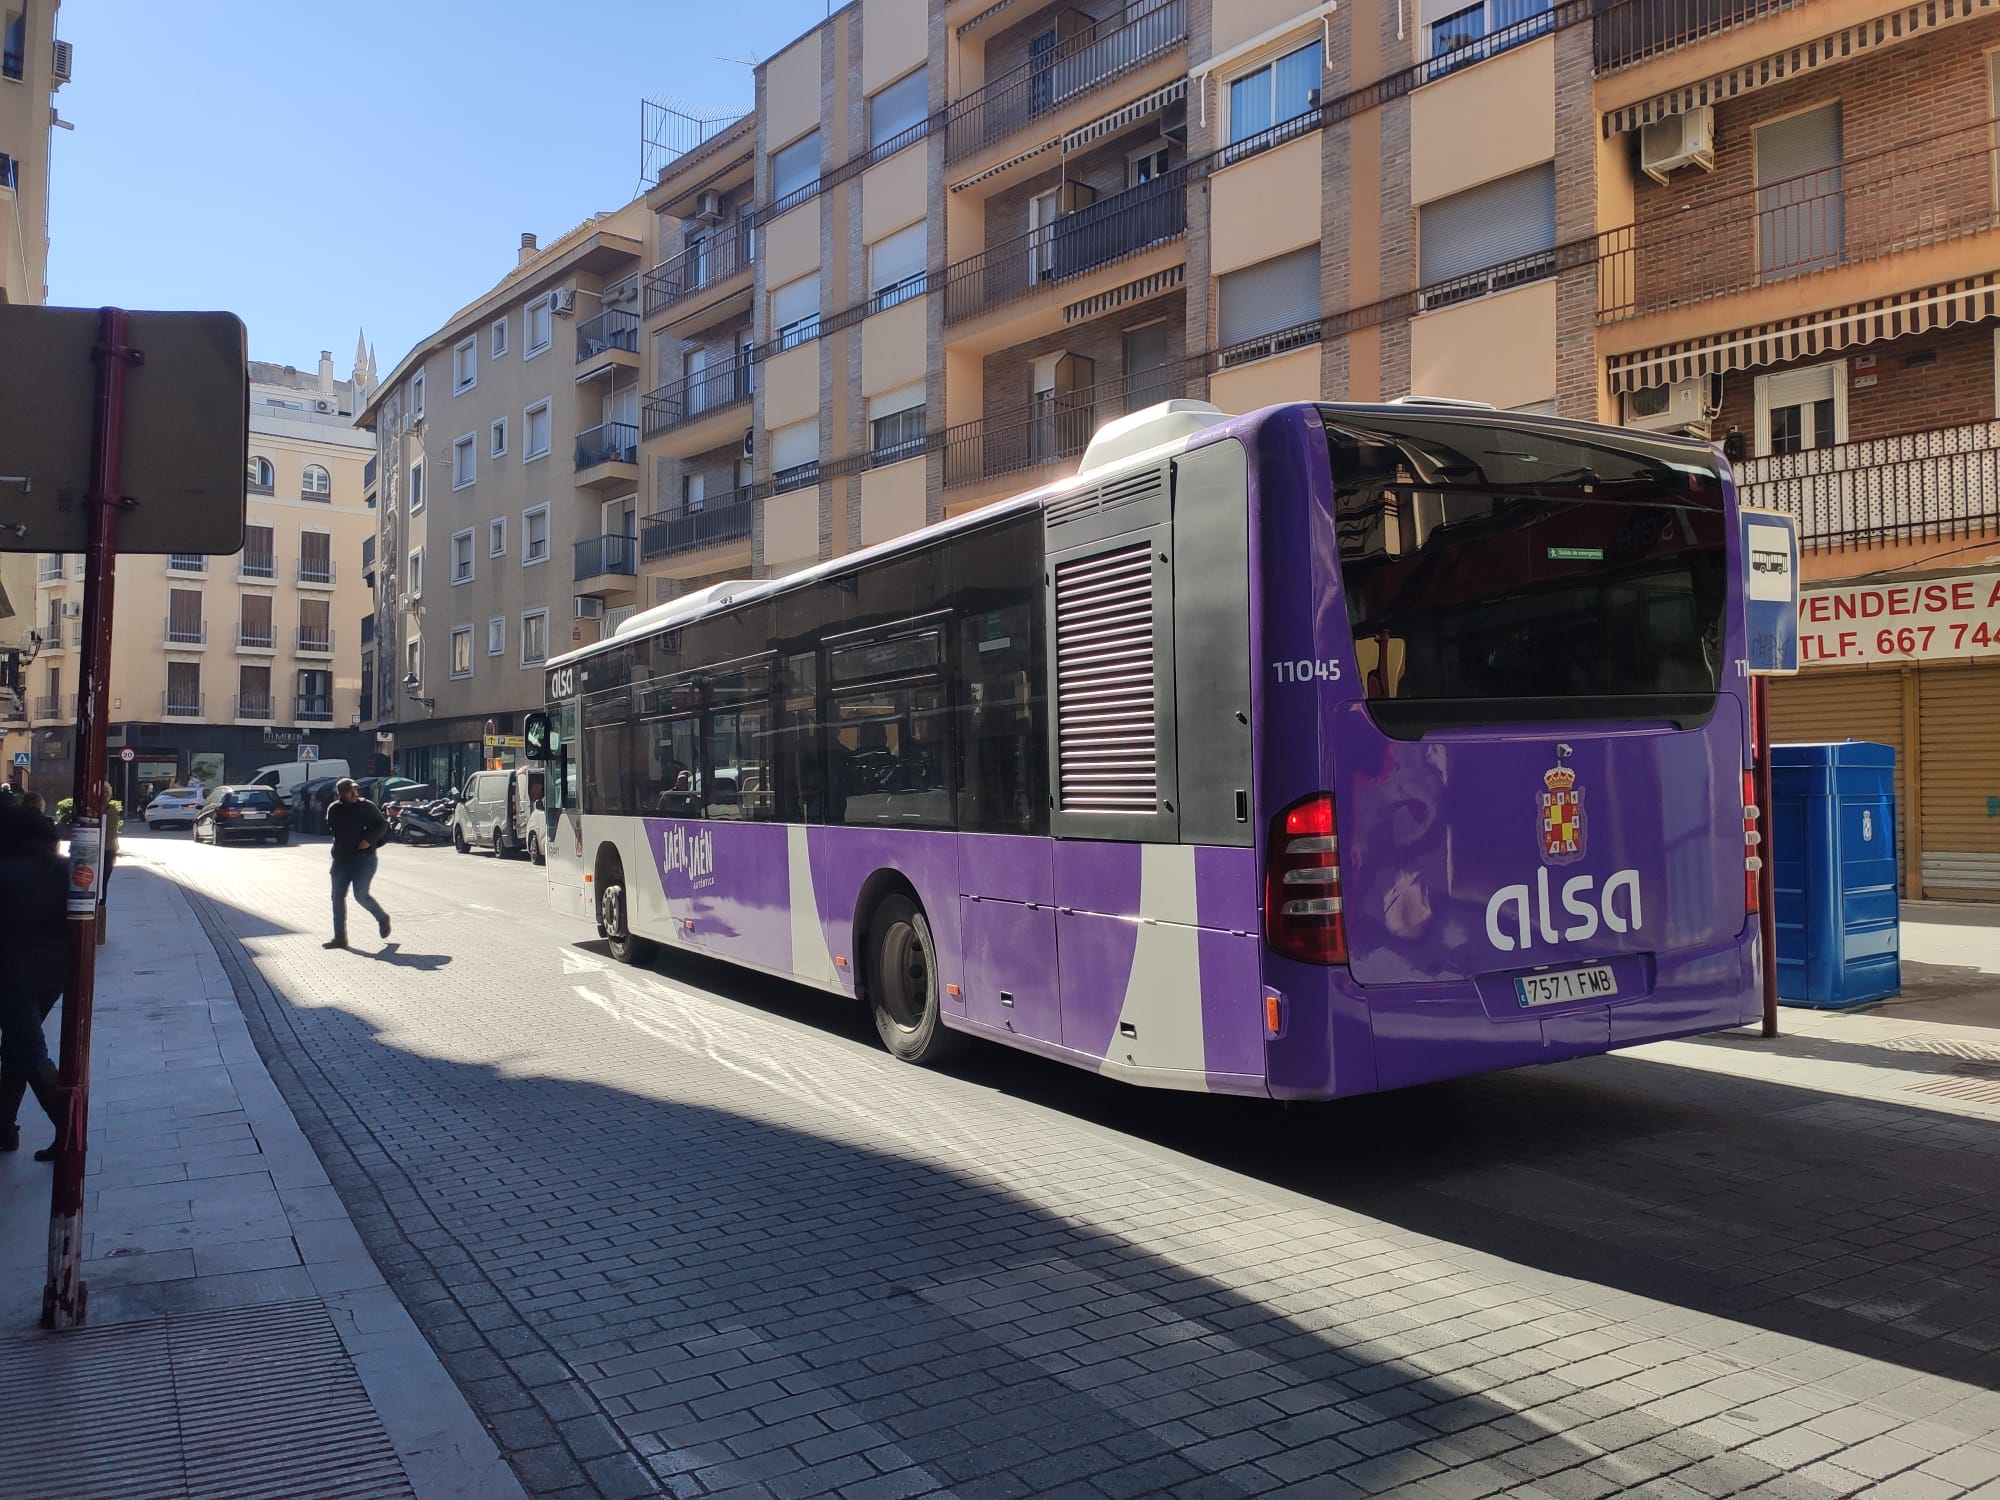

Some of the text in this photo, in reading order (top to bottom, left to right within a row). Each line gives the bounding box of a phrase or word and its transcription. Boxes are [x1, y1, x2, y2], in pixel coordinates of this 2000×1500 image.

[1800, 631, 1864, 660] TLF.
[1876, 626, 1936, 655] 667
[552, 668, 573, 699] alsa
[1272, 659, 1341, 683] 11045
[688, 828, 713, 880] JAÉN
[1485, 865, 1642, 951] alsa
[1528, 970, 1611, 1002] 7571 FMB
